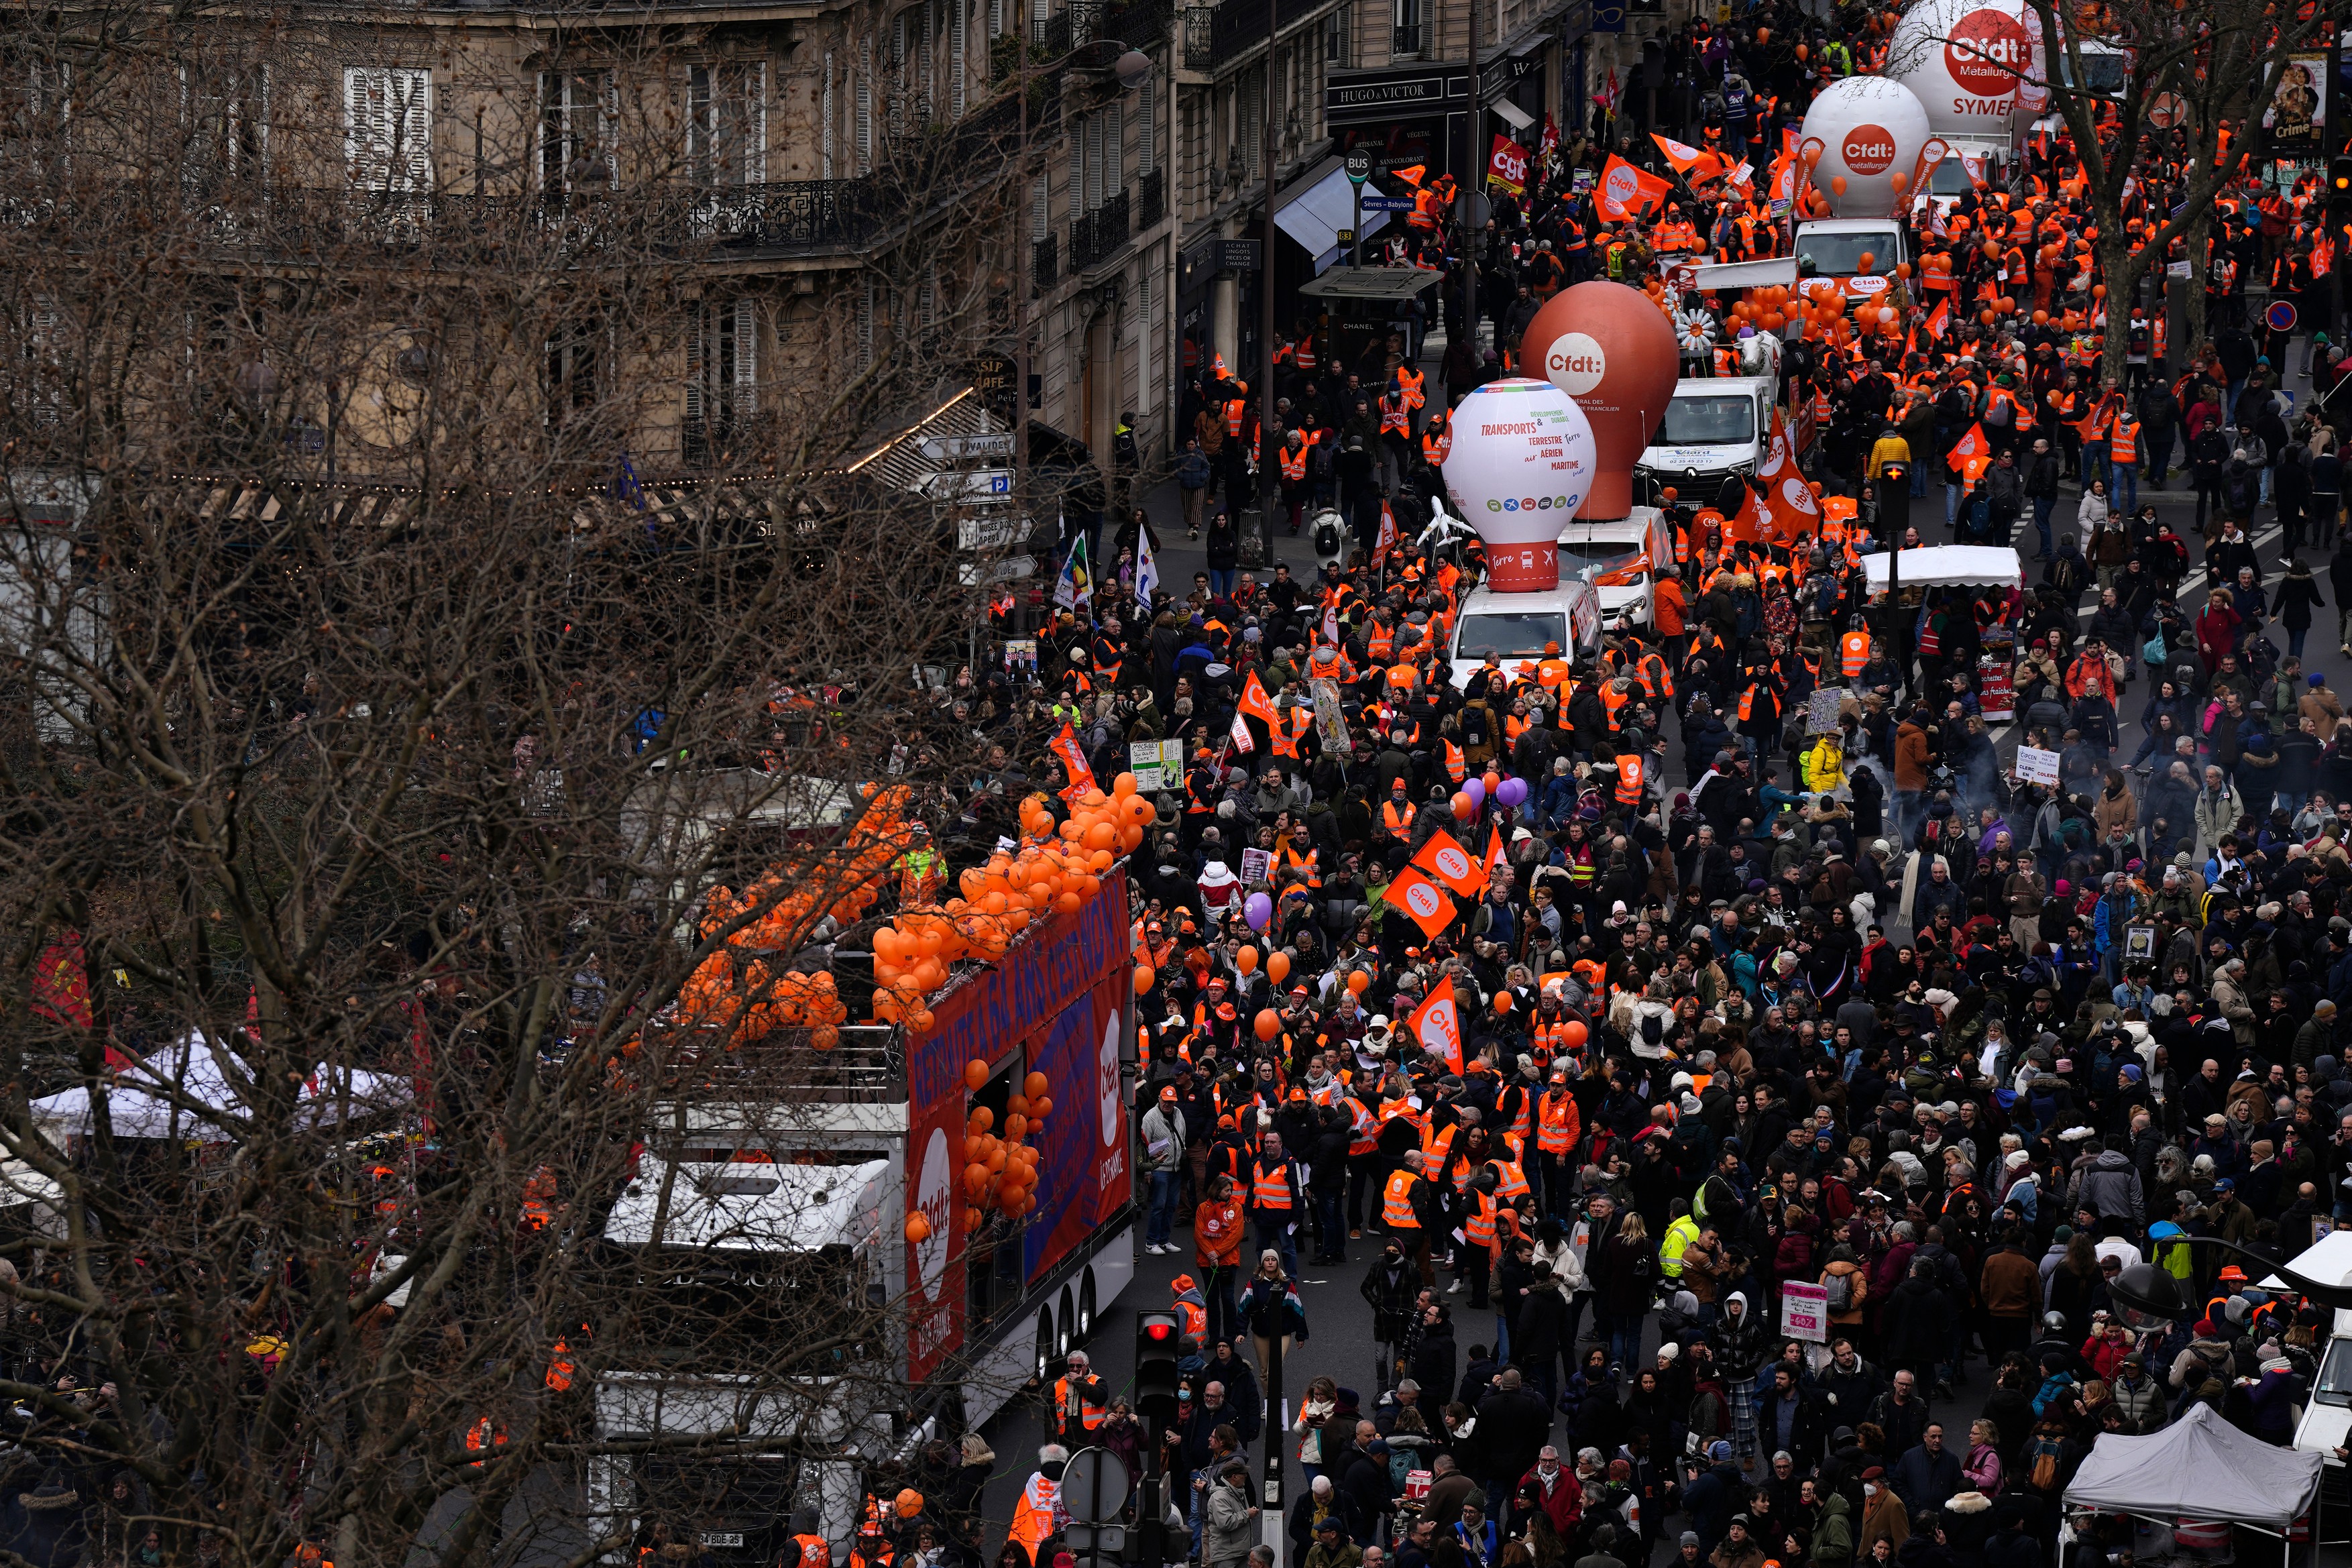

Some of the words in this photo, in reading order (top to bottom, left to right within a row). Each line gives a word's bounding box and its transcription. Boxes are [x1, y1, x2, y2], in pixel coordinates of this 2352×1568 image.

[1341, 89, 1374, 102] HUGO
[1376, 91, 1382, 100] &
[1382, 84, 1425, 98] VICTOR
[2276, 123, 2310, 138] Crime
[1354, 139, 1384, 148] ARTISANAL
[1846, 143, 1892, 158] Cfdt:
[1925, 148, 1942, 156] Cfdt:
[1348, 158, 1367, 168] BUS
[1394, 156, 1424, 164] COLORANT
[1849, 162, 1889, 170] métallurgie
[1494, 153, 1526, 180] cgt
[1609, 175, 1636, 193] Cfdt:
[1911, 162, 1931, 200] métallurgie
[1388, 201, 1413, 209] Babylone
[981, 361, 1003, 372] SIP
[1549, 354, 1602, 373] Cfdt:
[1530, 409, 1564, 418] DÉVELOPPEMENT
[1551, 415, 1569, 424] DURABLE
[1481, 422, 1536, 436] TRANSPORTS
[1536, 418, 1543, 426] &
[1528, 435, 1563, 446] TERRESTRE
[1564, 433, 1581, 445] terre
[1524, 453, 1537, 463] air
[1541, 447, 1563, 458] AÉRIEN
[1551, 460, 1579, 470] MARITIME
[1572, 467, 1585, 477] mer
[979, 522, 997, 533] MUSEE
[978, 535, 1000, 544] OPERA
[1492, 554, 1514, 570] terre
[1989, 687, 2012, 699] fraîches
[2019, 764, 2035, 772] CLERC
[1441, 852, 1464, 877] Cfdt:
[1410, 888, 1434, 913] Cfdt:
[913, 1012, 974, 1111] RETRAITE
[988, 966, 1011, 1052] 64
[1014, 946, 1046, 1037] ANS
[1049, 931, 1082, 1009] C'EST
[1079, 889, 1113, 986] NON
[2317, 1216, 2332, 1224] FRANCE
[1784, 1285, 1802, 1294] OFFRE
[1803, 1289, 1827, 1298] SPECIALE
[1783, 1325, 1793, 1333] SUR
[1803, 1329, 1825, 1339] RETRAITES
